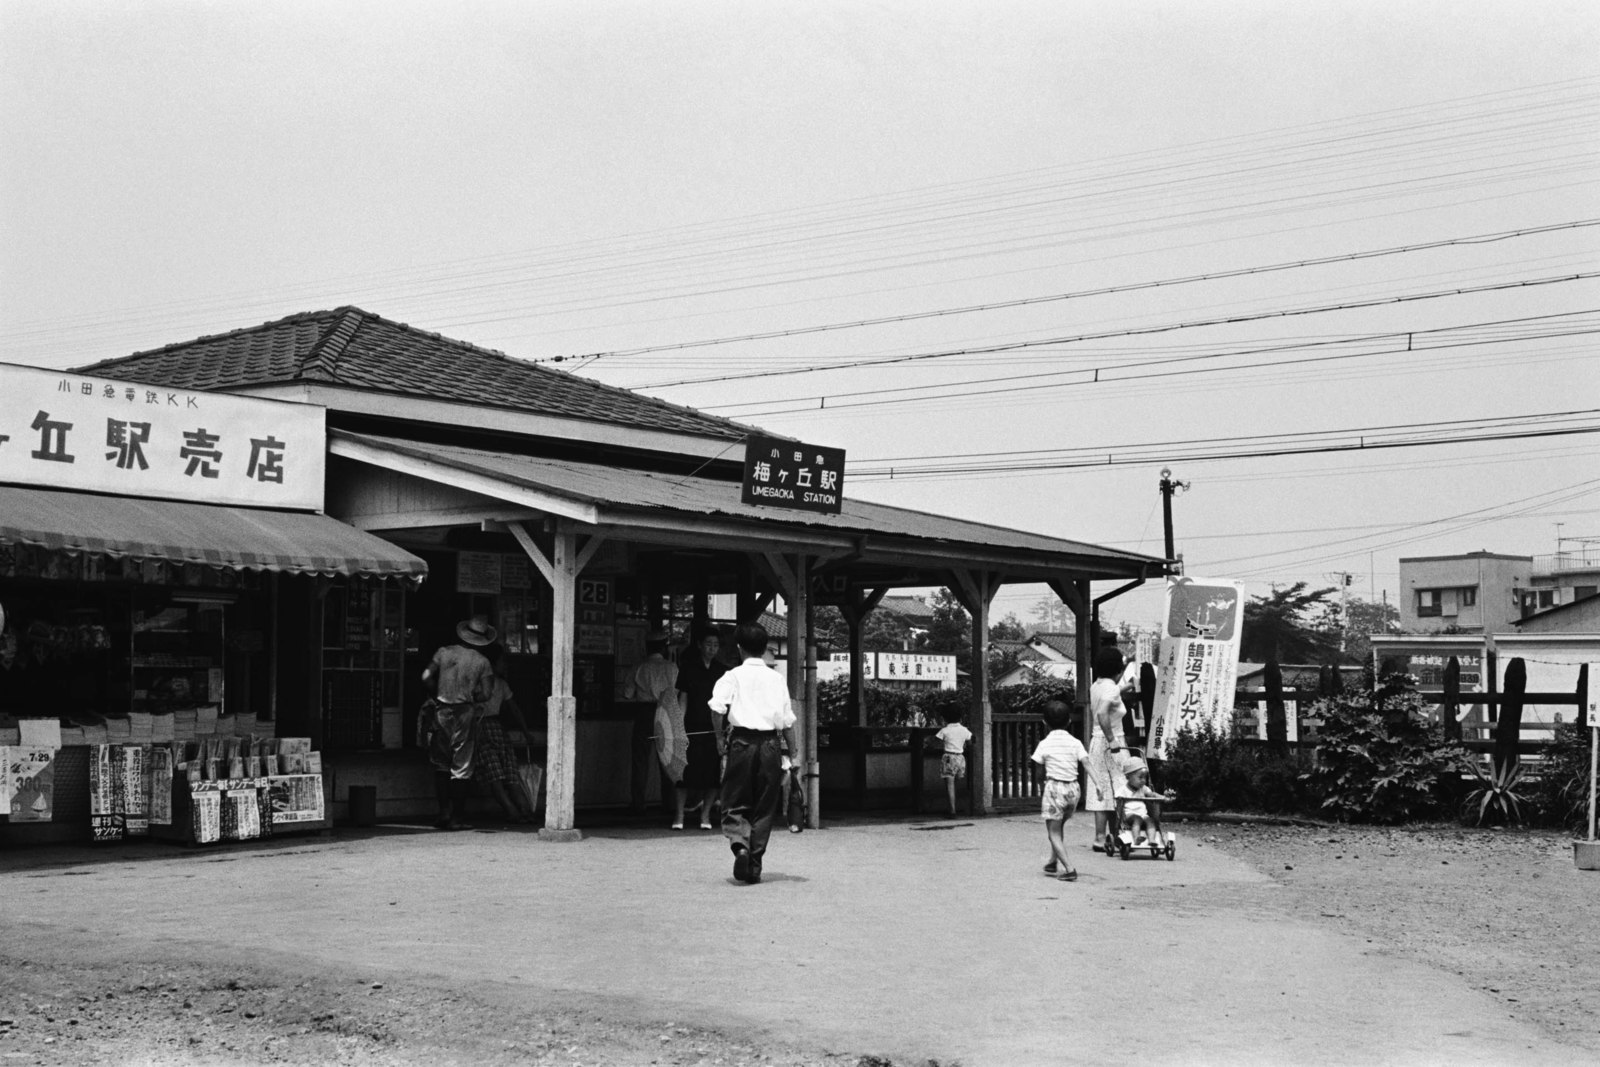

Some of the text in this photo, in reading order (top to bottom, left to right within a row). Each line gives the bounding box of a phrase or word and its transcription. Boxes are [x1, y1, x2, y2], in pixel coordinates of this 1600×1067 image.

[0, 409, 286, 485] 丘駅売店
[770, 448, 825, 466] 小田急
[752, 485, 836, 505] UMEGAOKA STATION
[582, 582, 608, 603] 28
